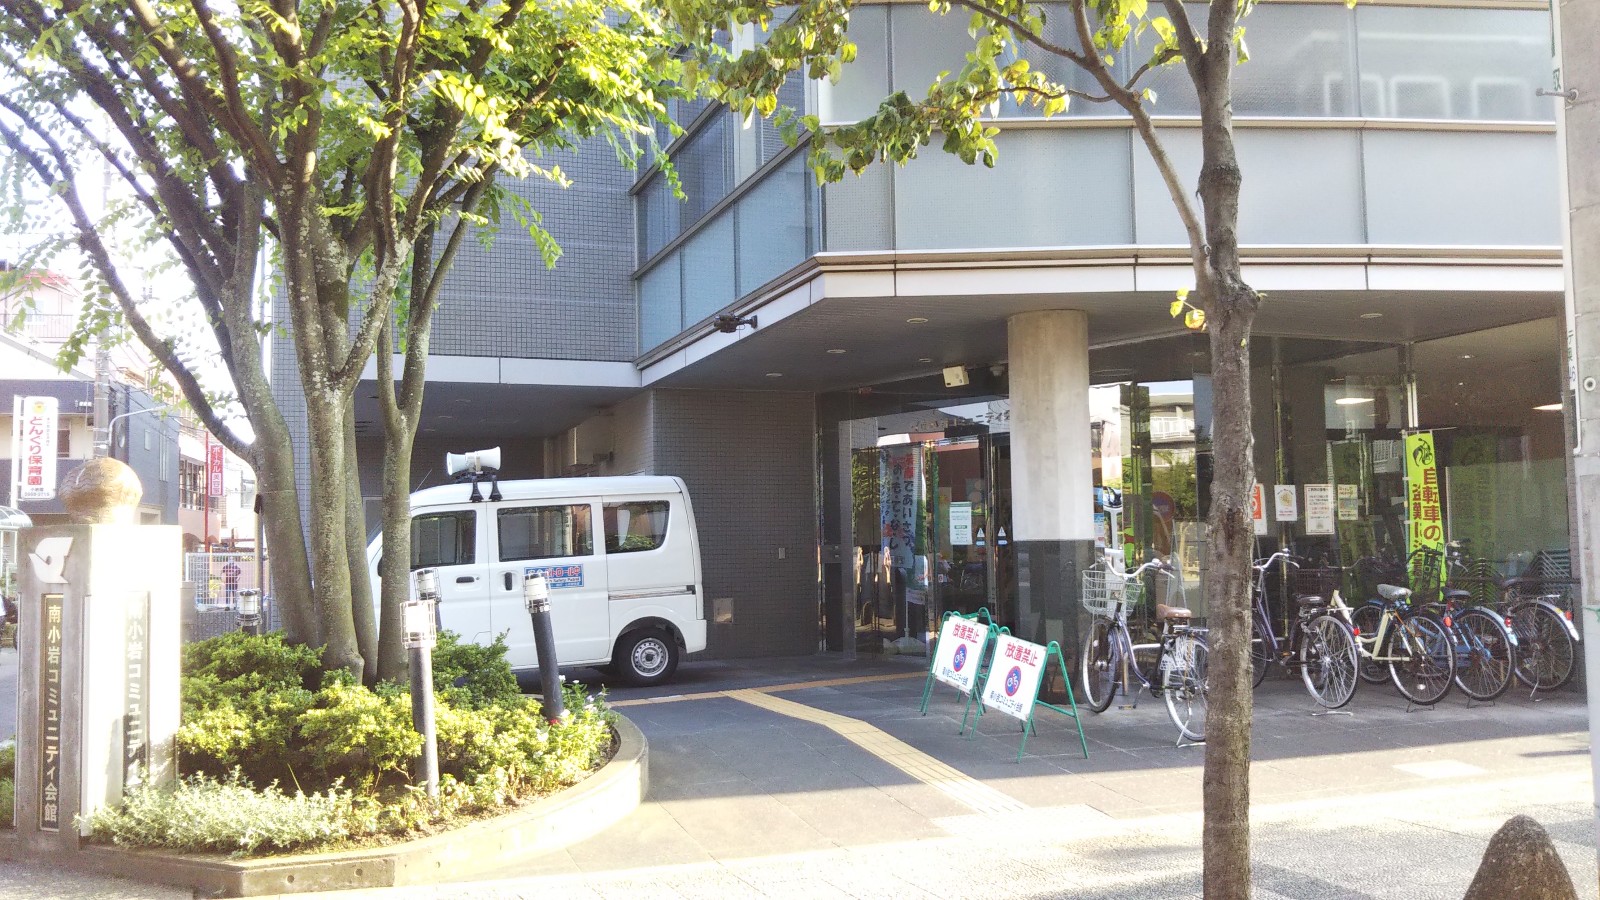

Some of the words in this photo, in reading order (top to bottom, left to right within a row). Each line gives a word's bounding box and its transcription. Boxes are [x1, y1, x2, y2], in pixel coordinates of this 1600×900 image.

[28, 416, 44, 486] どんぐり保育園
[1422, 467, 1442, 542] 自転車の
[952, 622, 980, 645] 放置禁止
[1004, 641, 1039, 668] 放置禁止
[44, 605, 62, 823] 南小岩コミュニティ会館
